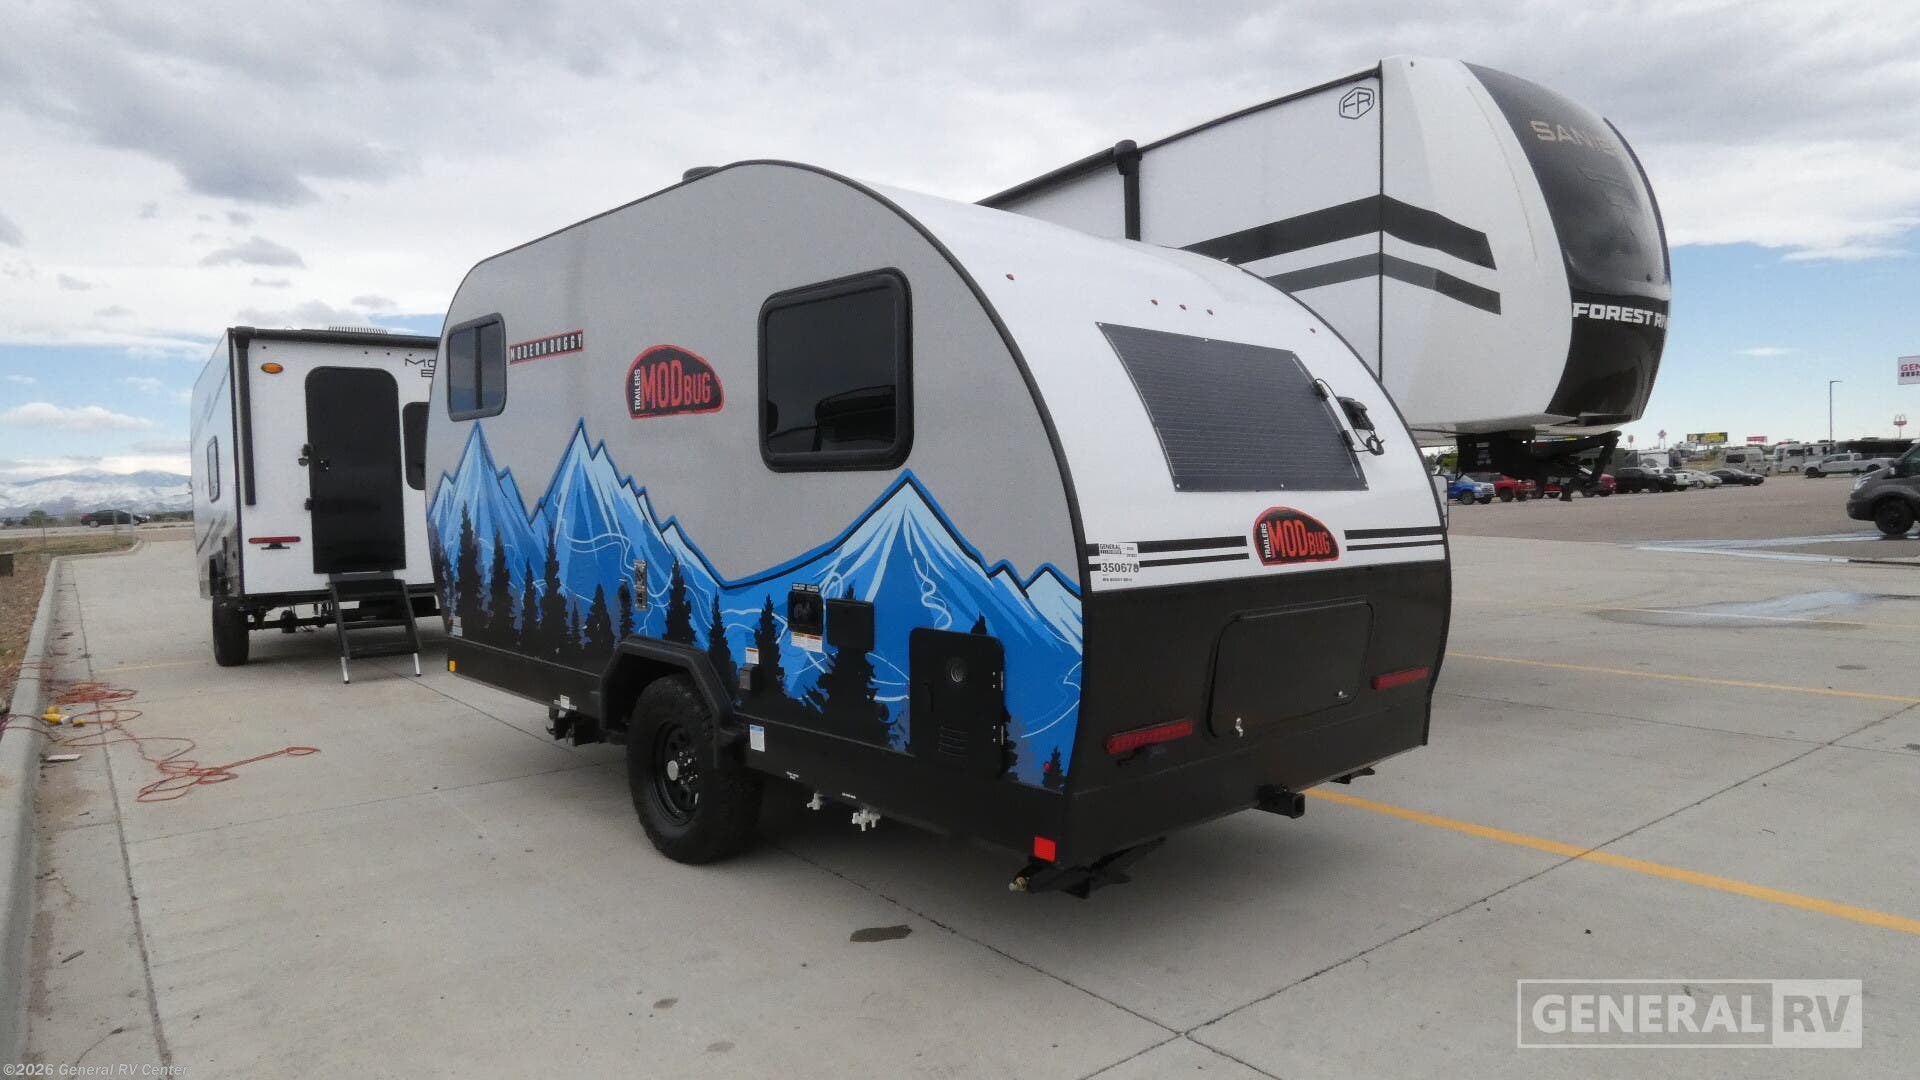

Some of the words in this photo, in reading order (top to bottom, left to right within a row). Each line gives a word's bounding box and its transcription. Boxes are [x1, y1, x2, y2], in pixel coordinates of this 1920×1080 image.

[1572, 302, 1653, 325] FOREST
[510, 342, 547, 361] MODERN
[550, 333, 582, 353] BUGGY
[1260, 522, 1272, 559] TRAILERS
[1101, 562, 1140, 573] 350678
